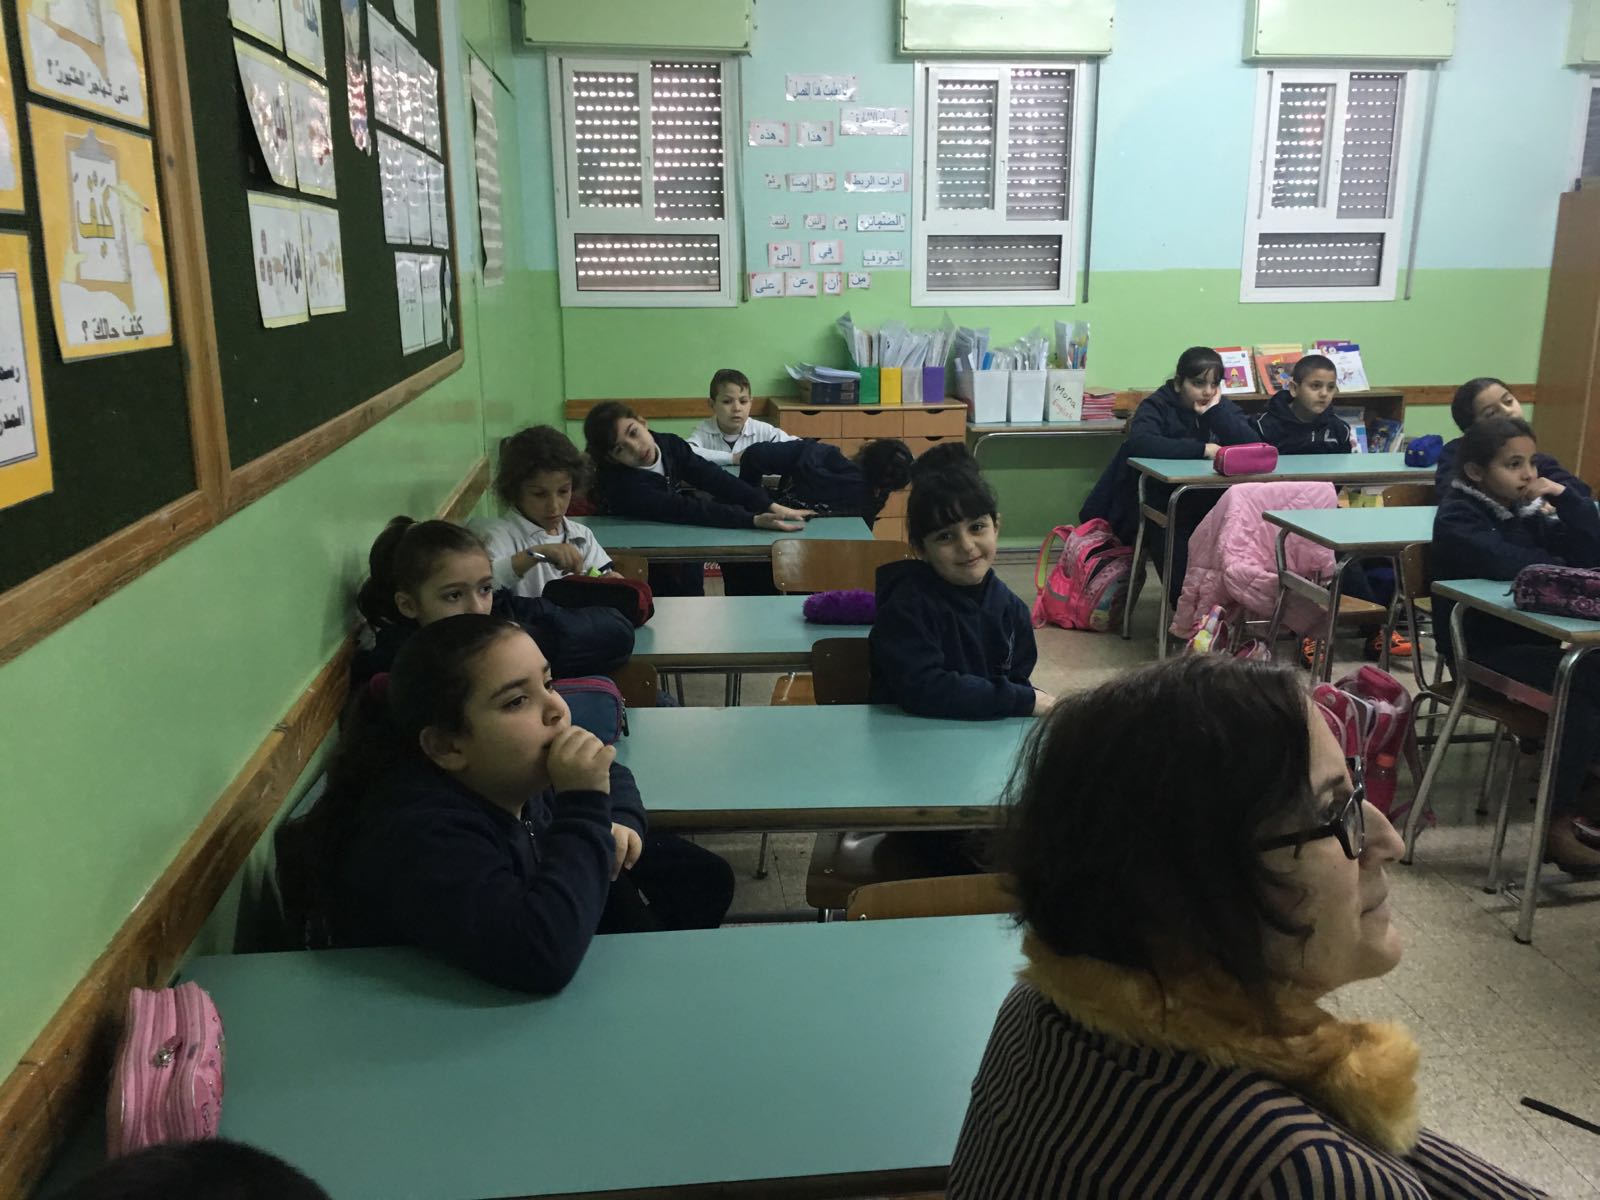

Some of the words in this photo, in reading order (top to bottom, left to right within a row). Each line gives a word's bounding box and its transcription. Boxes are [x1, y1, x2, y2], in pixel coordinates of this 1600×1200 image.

[760, 128, 776, 140] هذه
[807, 131, 822, 142] هذا
[852, 175, 875, 189] الربط
[776, 246, 793, 261] إلى
[819, 244, 834, 260] في
[754, 276, 775, 294] على
[792, 275, 809, 288] عن
[852, 275, 867, 287] من
[1055, 384, 1076, 409] Mona
